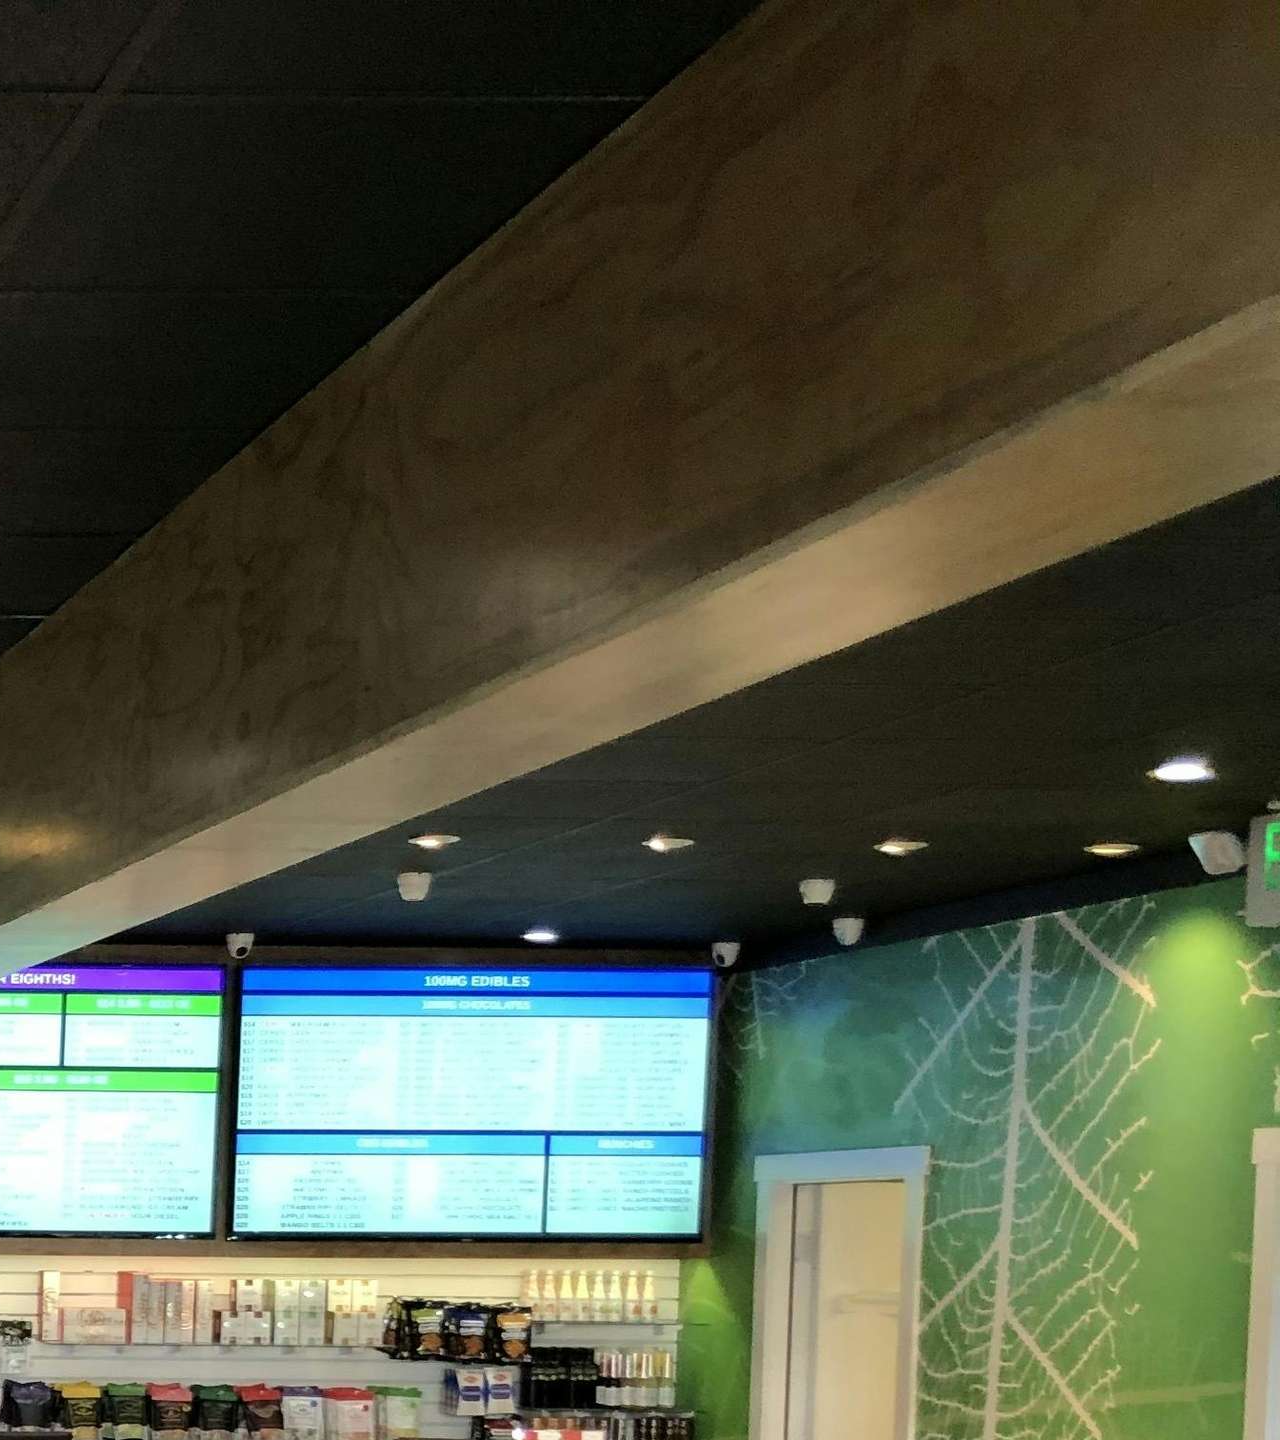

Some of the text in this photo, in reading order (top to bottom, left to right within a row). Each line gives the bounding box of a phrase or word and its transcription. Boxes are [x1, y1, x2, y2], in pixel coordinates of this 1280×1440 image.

[10, 973, 76, 985] EIGHTHS!
[424, 975, 531, 987] 100MG EDIBLES
